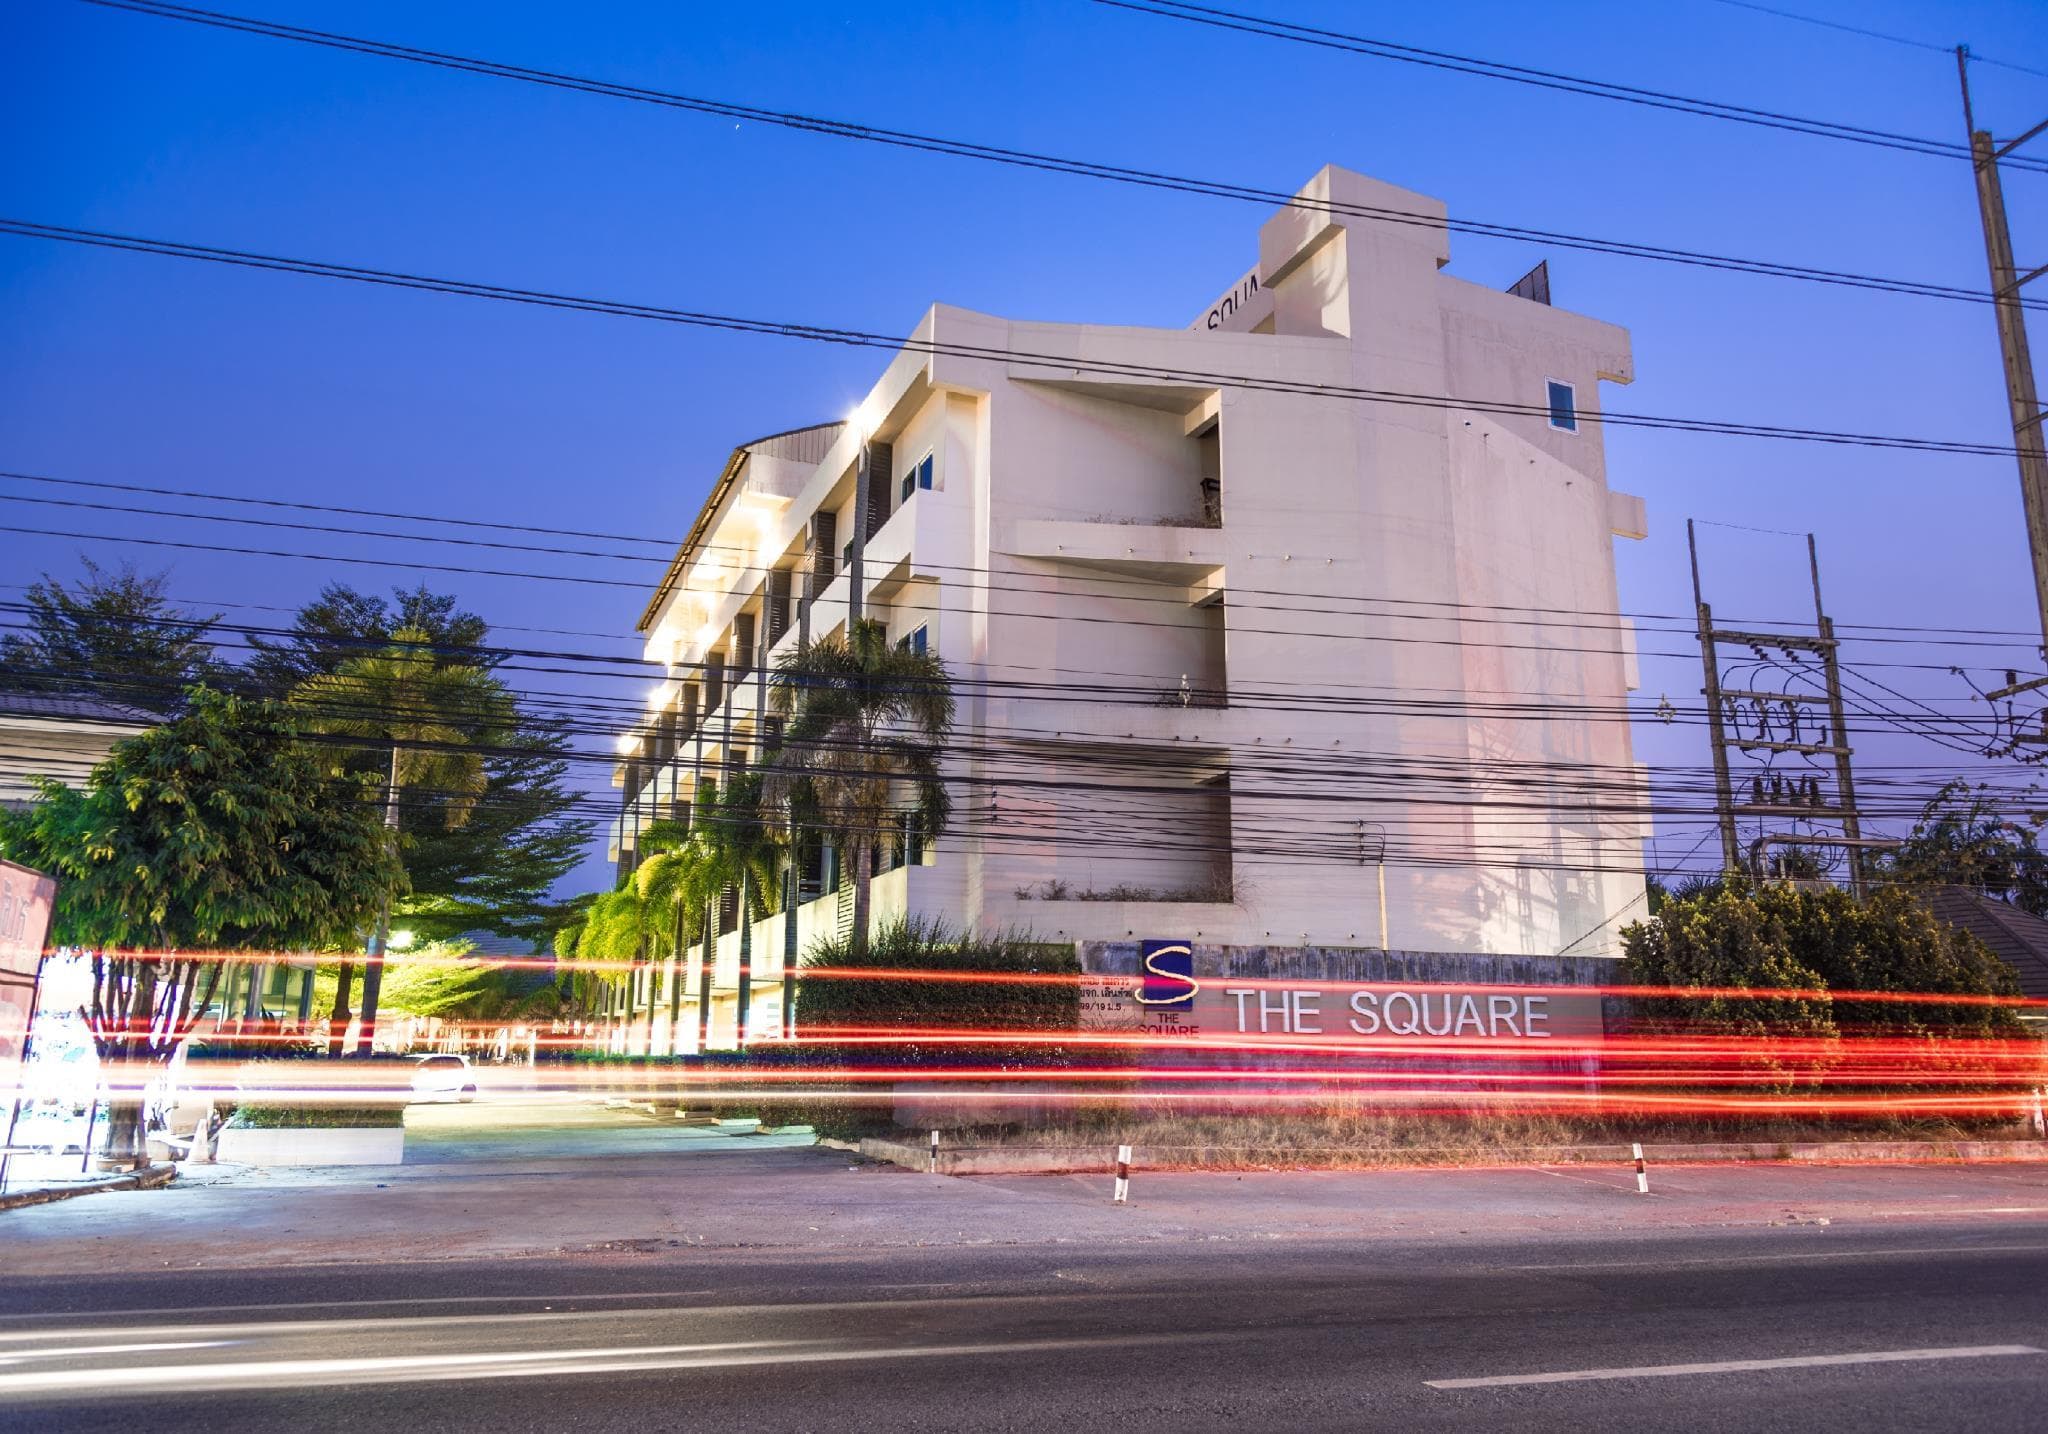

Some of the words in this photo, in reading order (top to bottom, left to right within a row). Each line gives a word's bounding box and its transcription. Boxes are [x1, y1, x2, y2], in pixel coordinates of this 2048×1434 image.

[1158, 1013, 1180, 1024] THE
[1226, 989, 1322, 1034] THE
[1350, 991, 1551, 1037] SQUARE
[1138, 1024, 1200, 1039] SQUARE
